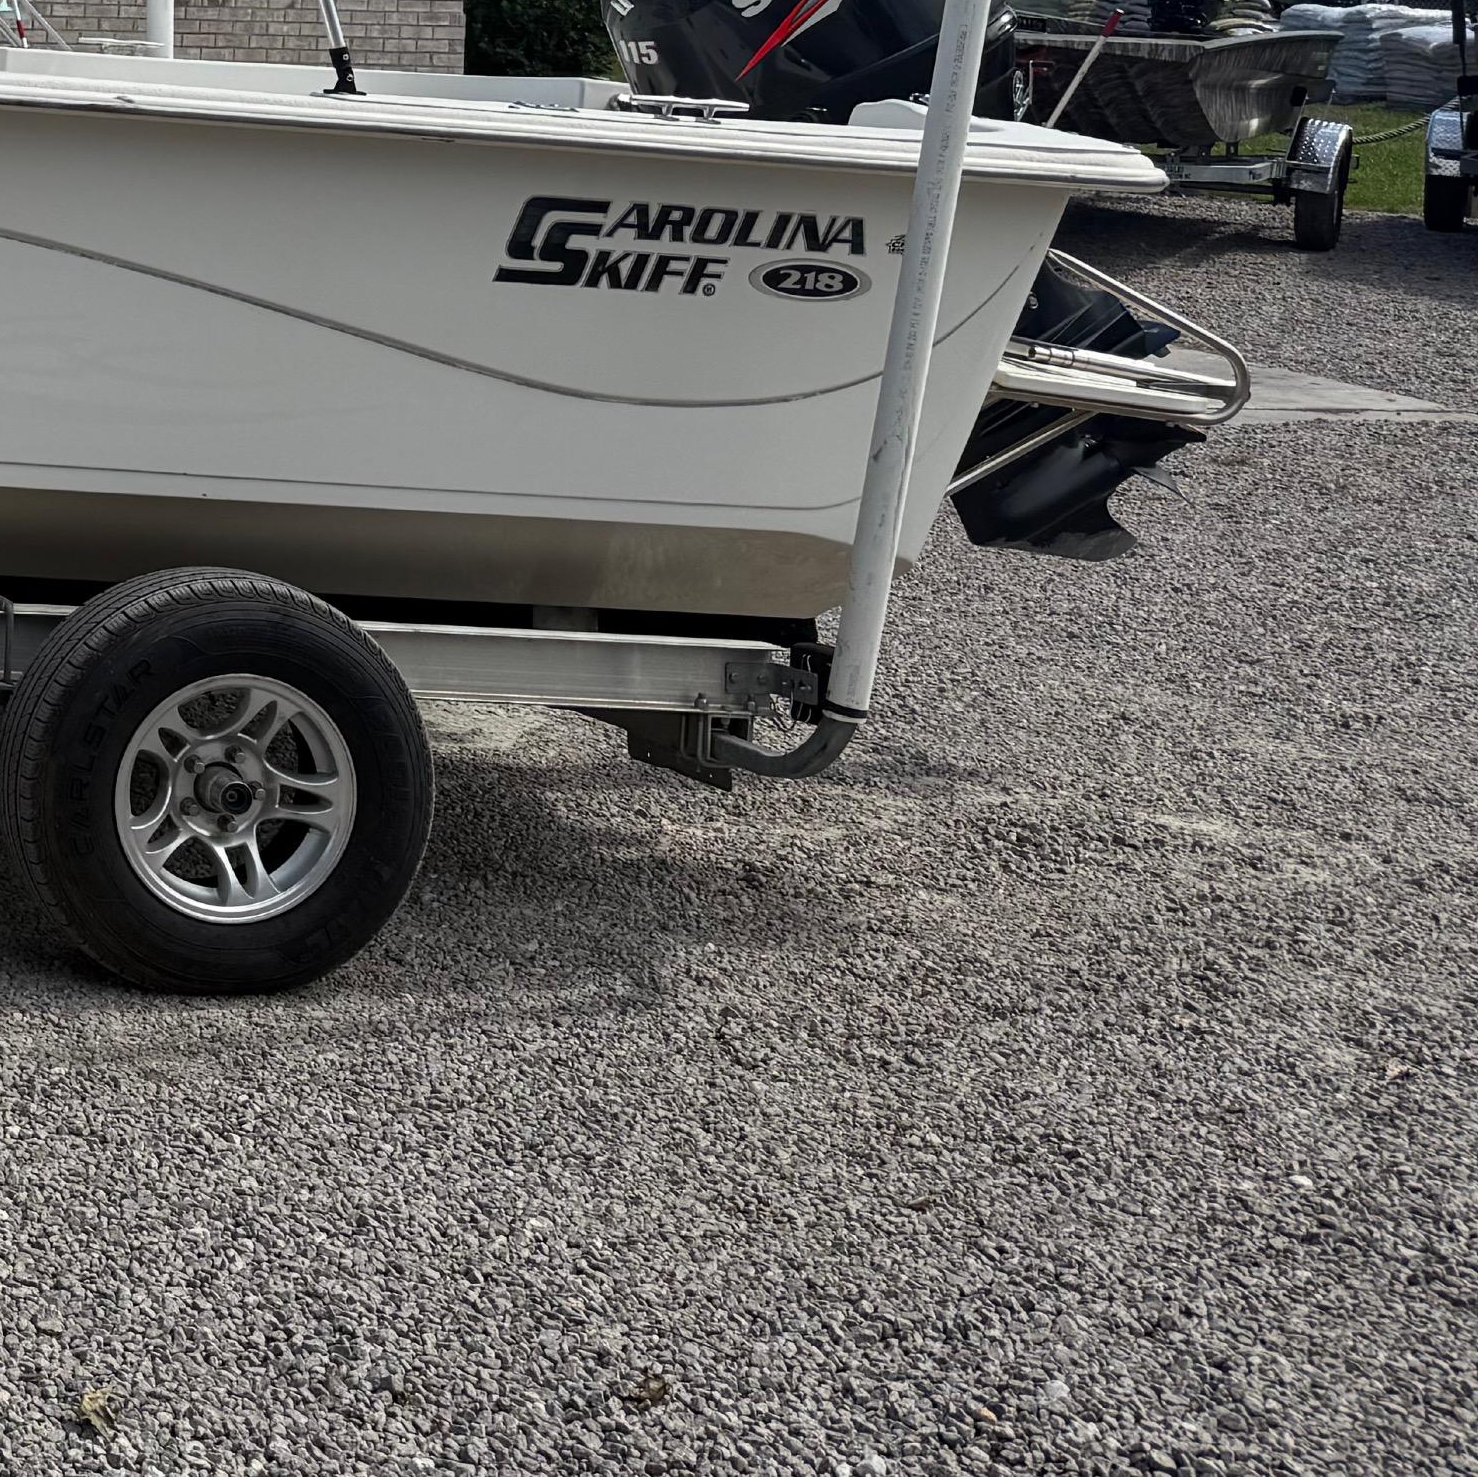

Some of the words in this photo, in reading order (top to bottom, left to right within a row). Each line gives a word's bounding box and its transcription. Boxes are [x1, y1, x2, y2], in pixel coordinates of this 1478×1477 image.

[619, 40, 659, 65] 115
[506, 195, 866, 260] CAROLINA
[776, 269, 844, 292] 218
